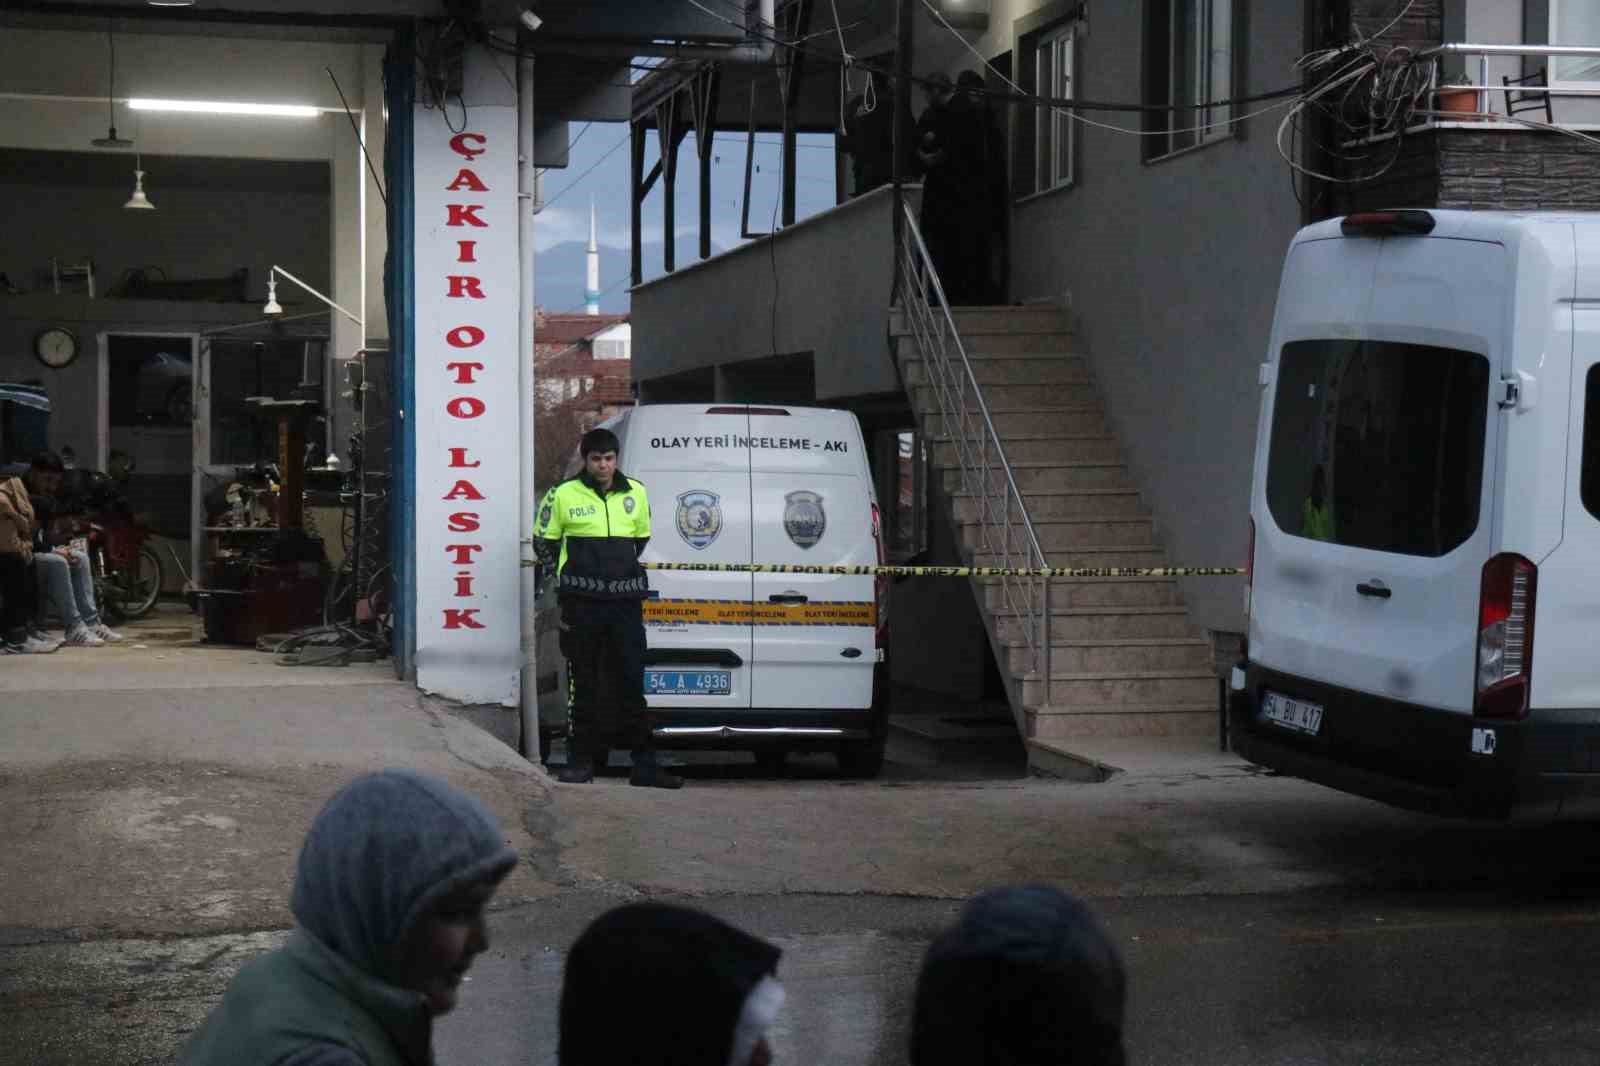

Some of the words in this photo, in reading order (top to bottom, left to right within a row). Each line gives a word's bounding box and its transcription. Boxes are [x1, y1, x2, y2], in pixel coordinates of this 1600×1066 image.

[445, 132, 489, 300] ÇAKIR
[445, 326, 487, 419] OTO
[651, 437, 690, 449] OLAY
[694, 435, 730, 448] YERİ
[733, 434, 811, 450] İNCELEME
[441, 446, 487, 630] LASTİK
[651, 674, 666, 688] 54
[677, 674, 686, 689] A
[696, 674, 728, 689] 4936
